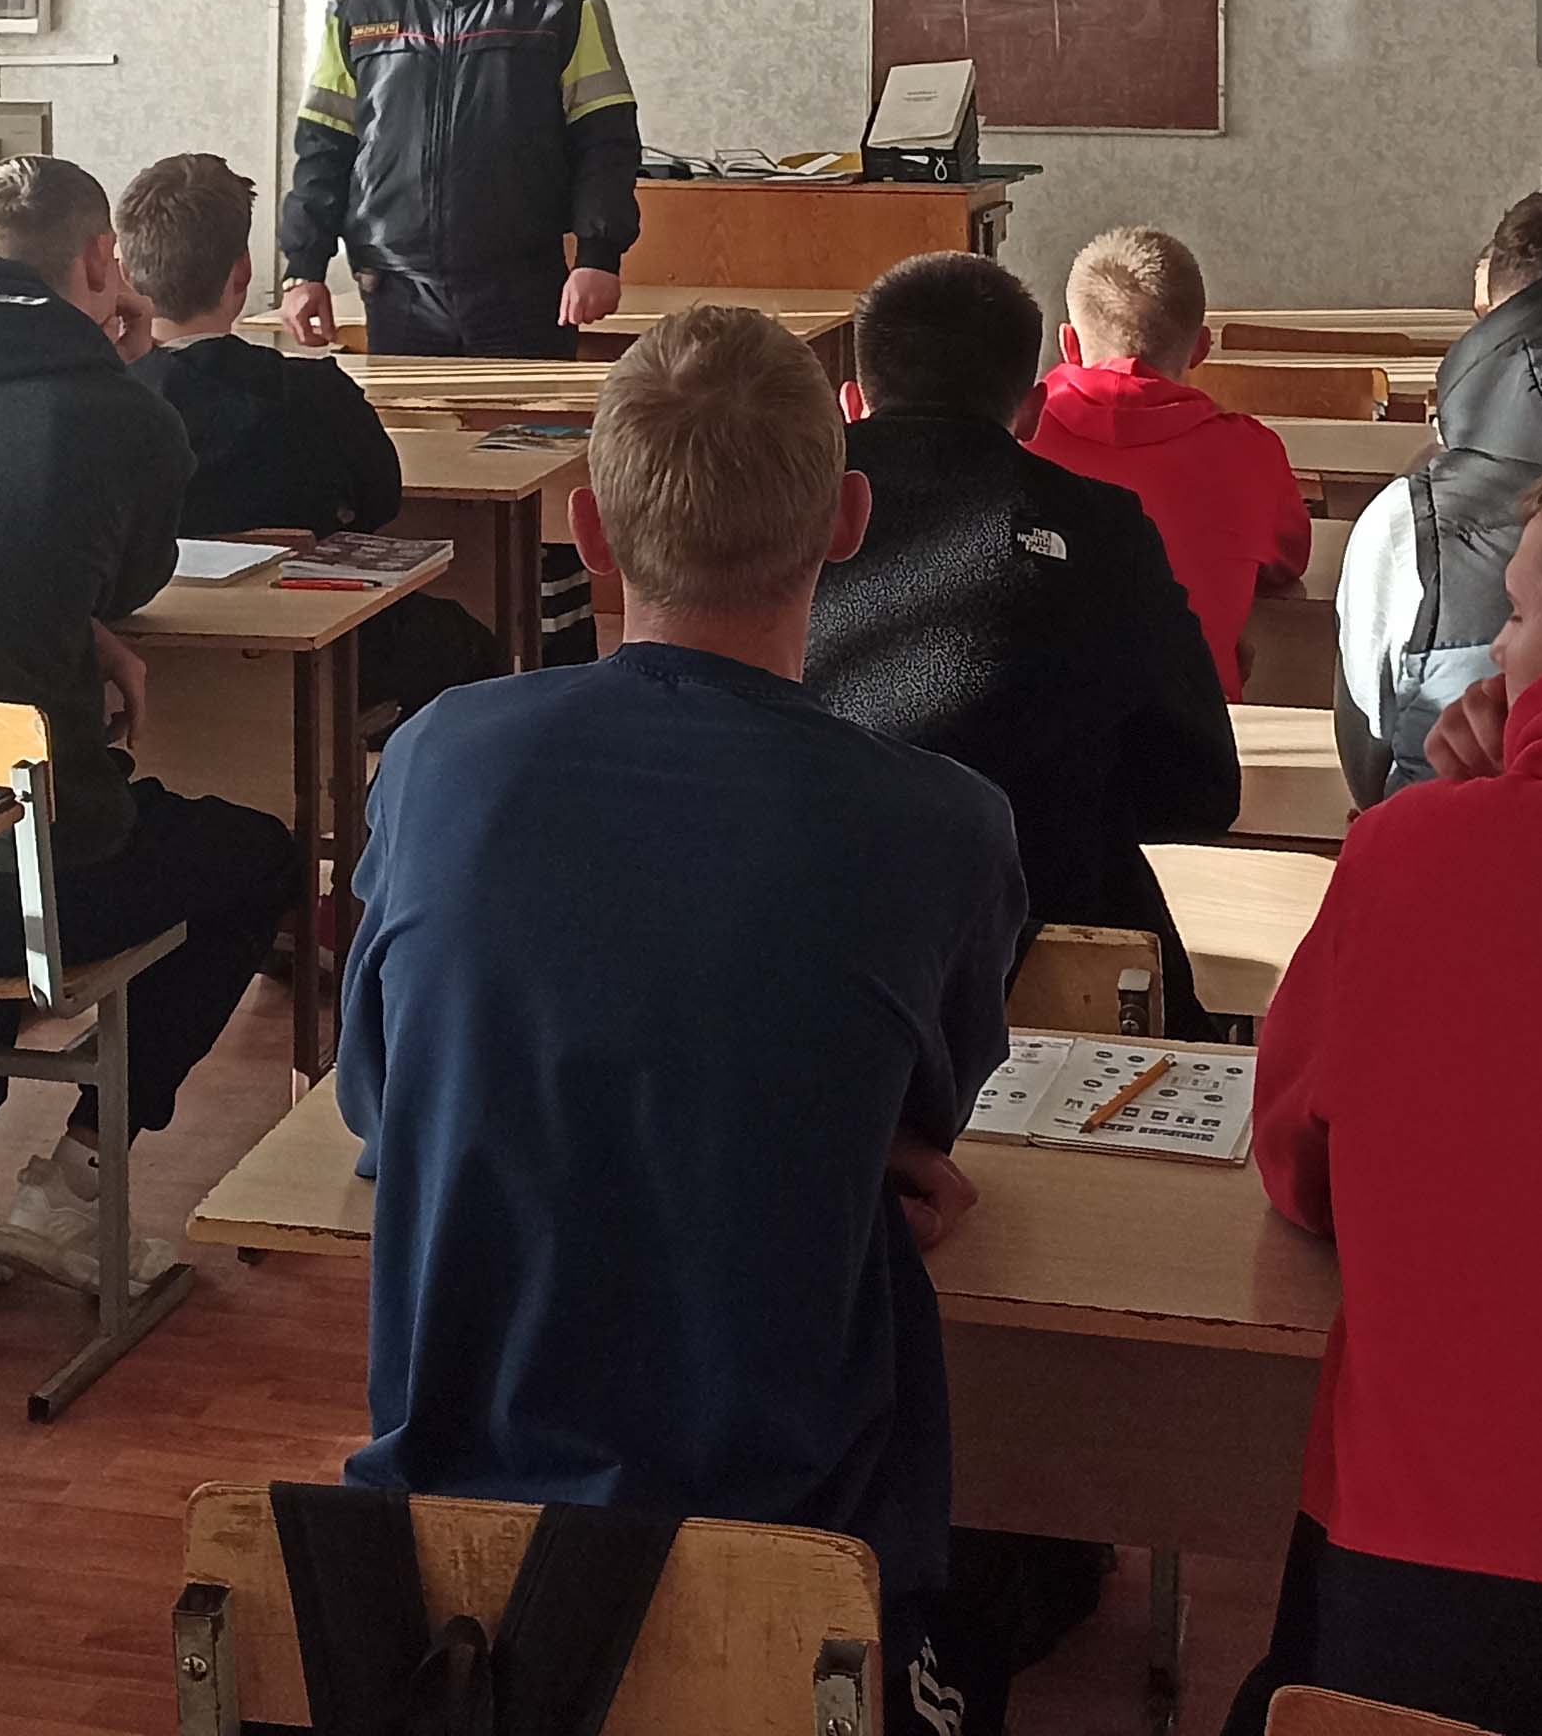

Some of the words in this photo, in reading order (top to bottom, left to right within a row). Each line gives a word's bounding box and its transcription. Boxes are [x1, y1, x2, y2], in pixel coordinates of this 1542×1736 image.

[1017, 532, 1051, 546] NORTH
[1033, 527, 1051, 538] THE
[1025, 542, 1051, 555] FACE
